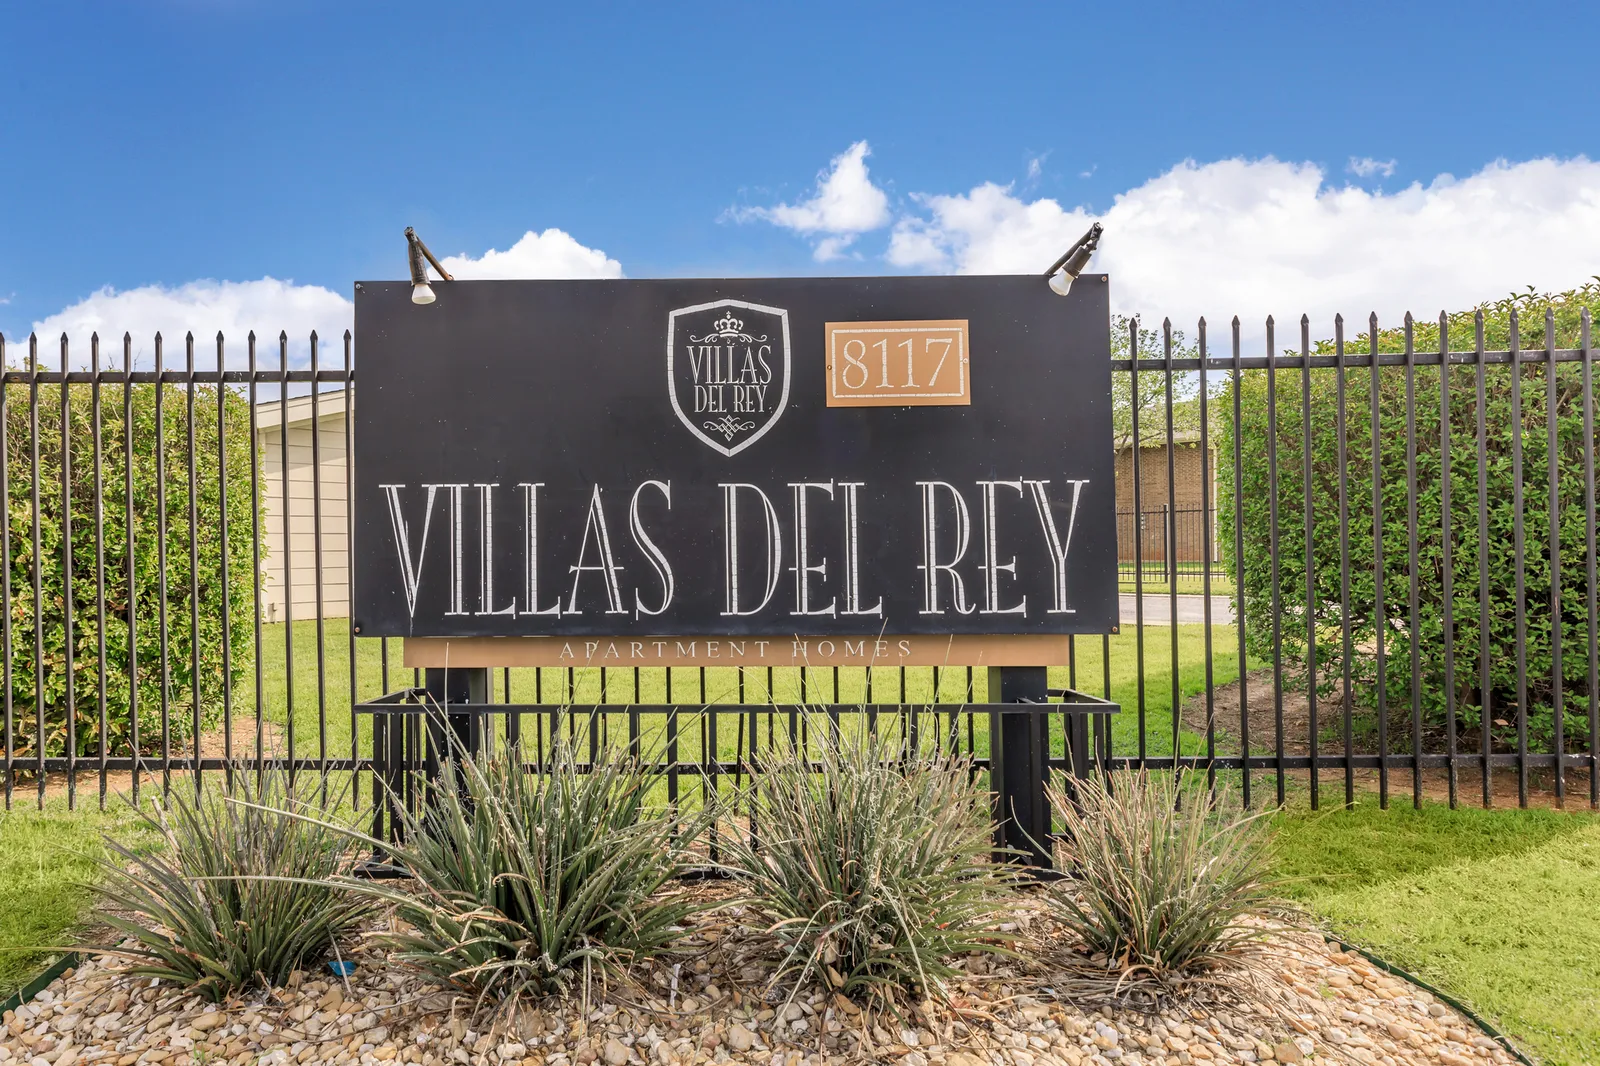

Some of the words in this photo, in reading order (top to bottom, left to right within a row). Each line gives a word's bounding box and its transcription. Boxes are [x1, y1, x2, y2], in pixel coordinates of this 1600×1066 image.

[686, 345, 772, 385] VILLAS
[842, 338, 953, 389] 8117
[694, 385, 727, 413] DEL
[733, 385, 768, 413] REY
[378, 480, 672, 620] VILLAS
[718, 478, 883, 619] DEL
[915, 476, 1090, 616] REY
[559, 640, 770, 659] APARTMENT
[792, 639, 912, 658] HOMES
